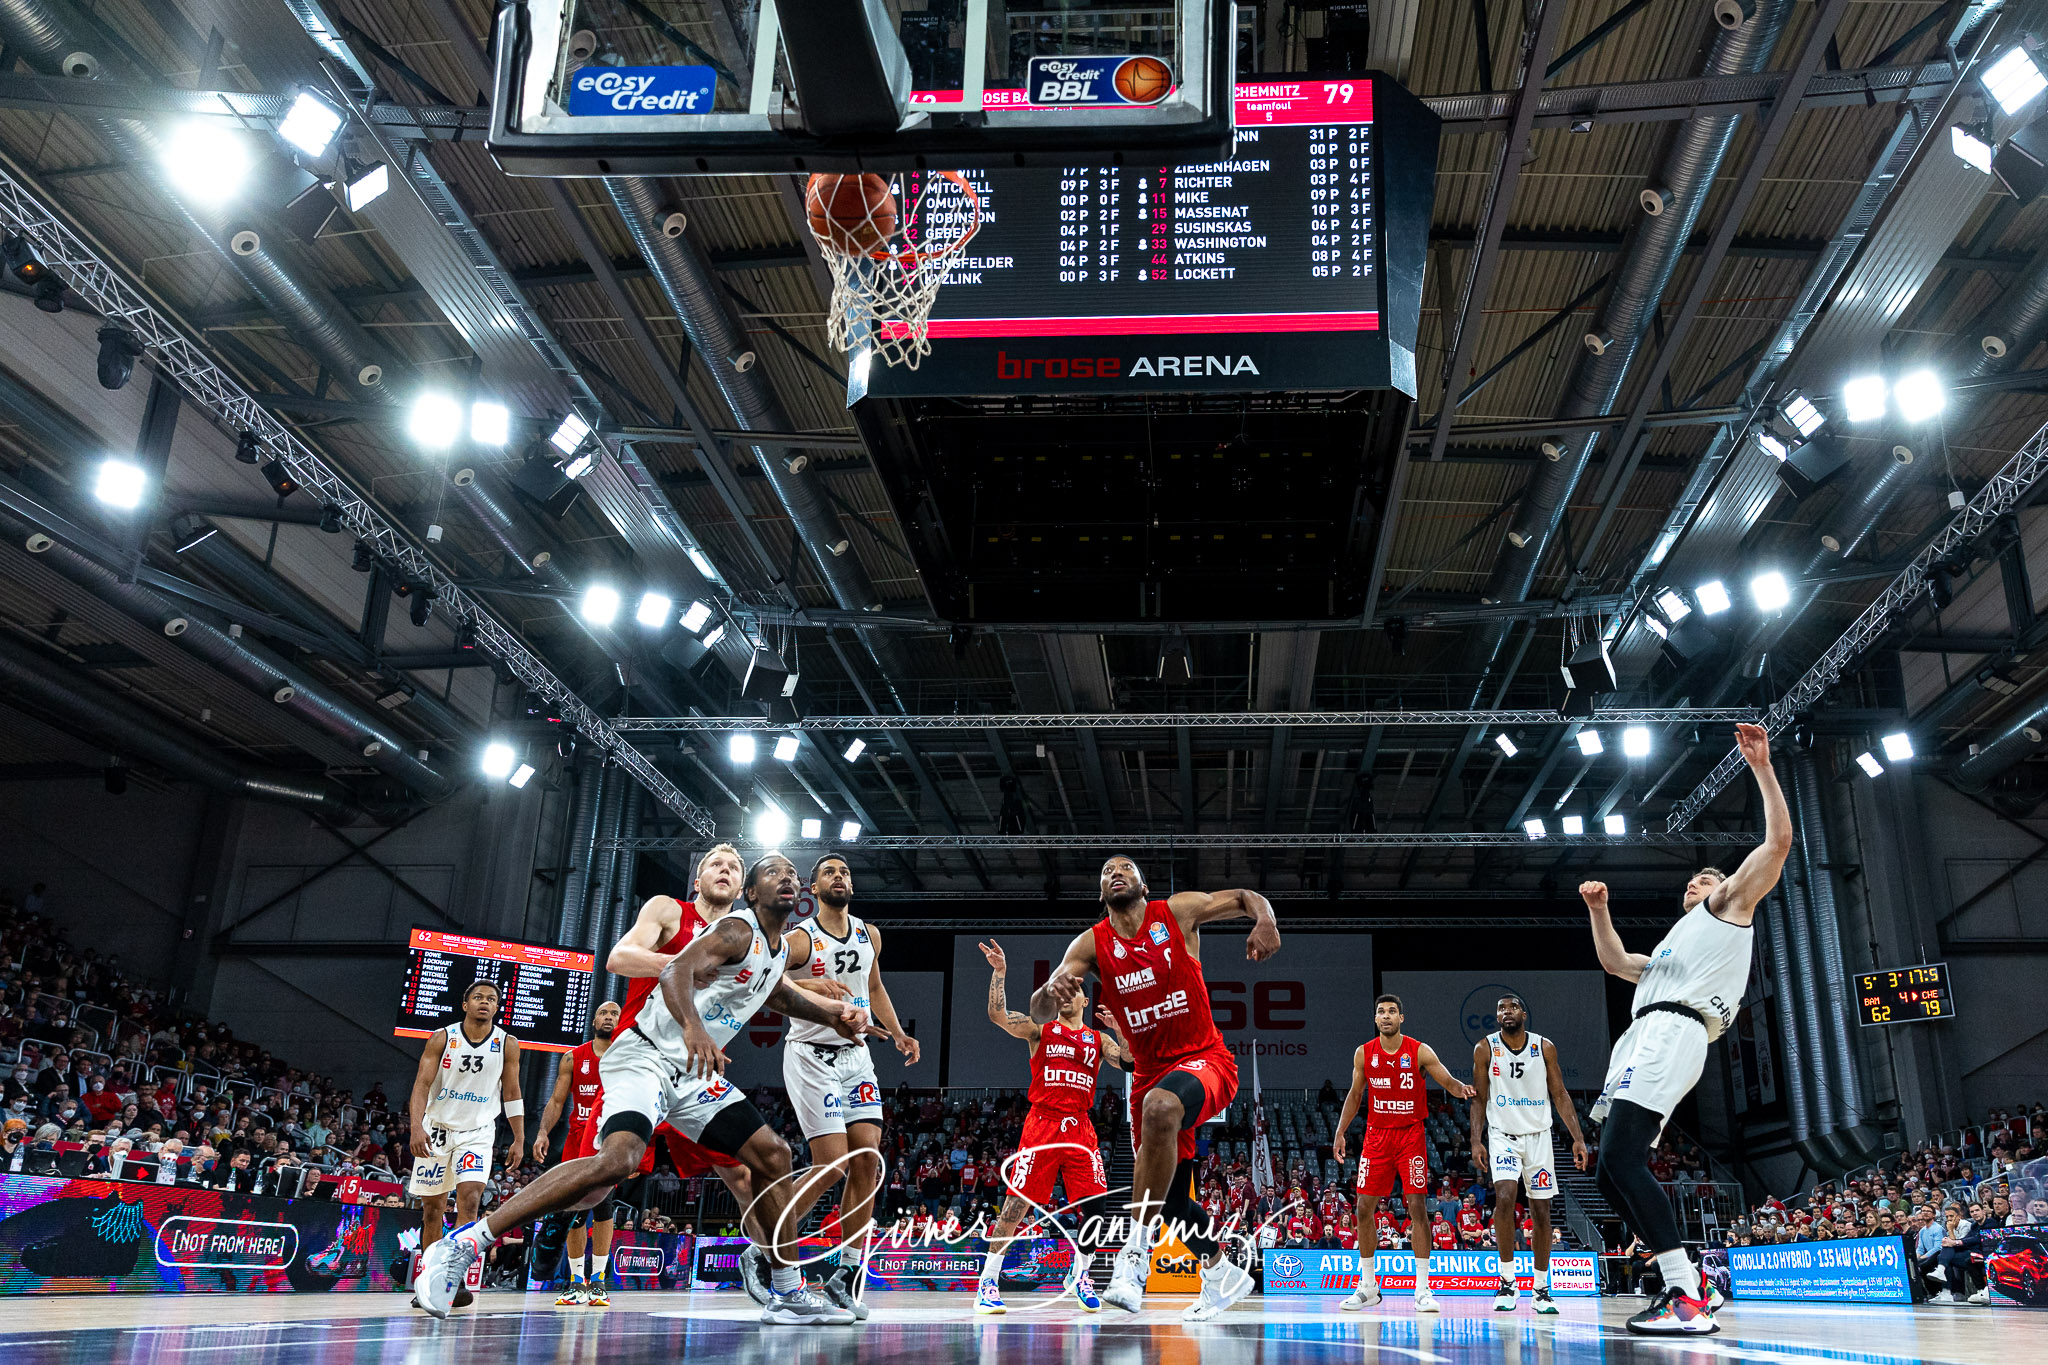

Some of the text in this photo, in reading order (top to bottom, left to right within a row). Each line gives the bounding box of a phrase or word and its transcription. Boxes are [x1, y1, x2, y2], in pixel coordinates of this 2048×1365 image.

[1057, 69, 1100, 81] Credit
[1038, 82, 1099, 101] BBL
[1324, 84, 1354, 104] 79
[611, 91, 699, 110] Credit
[1247, 101, 1291, 111] teamfoul
[1266, 112, 1273, 122] 5
[1310, 128, 1368, 140] 31 P 2 F
[1310, 143, 1369, 155] 00 P 0 F
[1310, 159, 1326, 170] 03
[1330, 159, 1338, 170] P
[1350, 158, 1357, 169] 0
[1361, 158, 1369, 169] F
[912, 183, 919, 193] 8
[1159, 173, 1370, 188] 7 RICHTER 03 P 4 F
[1152, 188, 1370, 204] 11 MIKE 09 P 4 F
[926, 211, 995, 223] ROBINSON
[1153, 204, 1370, 219] 15 MASSENAT 10 P 3 F
[1152, 219, 1371, 234] 29 SUSINSKAS 06 P 4 F
[1152, 234, 1371, 249] 33 WASHINGTON 04 P 2 F
[925, 257, 1013, 270] SENGFELDER
[1152, 249, 1372, 265] 44 ATKINS 08 P 4 F
[1152, 265, 1372, 280] 52 LOCKETT 05 P 2 F
[997, 351, 1260, 379] brose ARENA
[418, 931, 432, 942] 62
[576, 954, 588, 964] 79
[834, 950, 862, 975] 52
[1115, 971, 1142, 990] LVM
[1864, 990, 1939, 1006] BAM 4 CHE
[1871, 1000, 1940, 1022] 62 79
[1046, 1044, 1066, 1054] LVM
[459, 1055, 484, 1073] 33
[1083, 1046, 1096, 1068] 12
[1044, 1066, 1094, 1088] brose
[1509, 1062, 1525, 1079] 15
[1400, 1073, 1414, 1089] 25
[1374, 1096, 1414, 1111] brose
[1508, 1098, 1545, 1106] Staffbase
[417, 1163, 446, 1178] CWE
[210, 1235, 245, 1253] FROM
[911, 1260, 941, 1270] FROM
[1320, 1255, 1534, 1273] ATB UTOTCHNIK GBH
[1552, 1259, 1591, 1267] TOYOTA
[1733, 1245, 1898, 1270] COROLLA 2.0 HYBRID 135 kW (184 PS)
[1156, 1258, 1199, 1274] SIXT
[1553, 1269, 1592, 1277] HYBRID
[1270, 1280, 1307, 1289] TOYOTA
